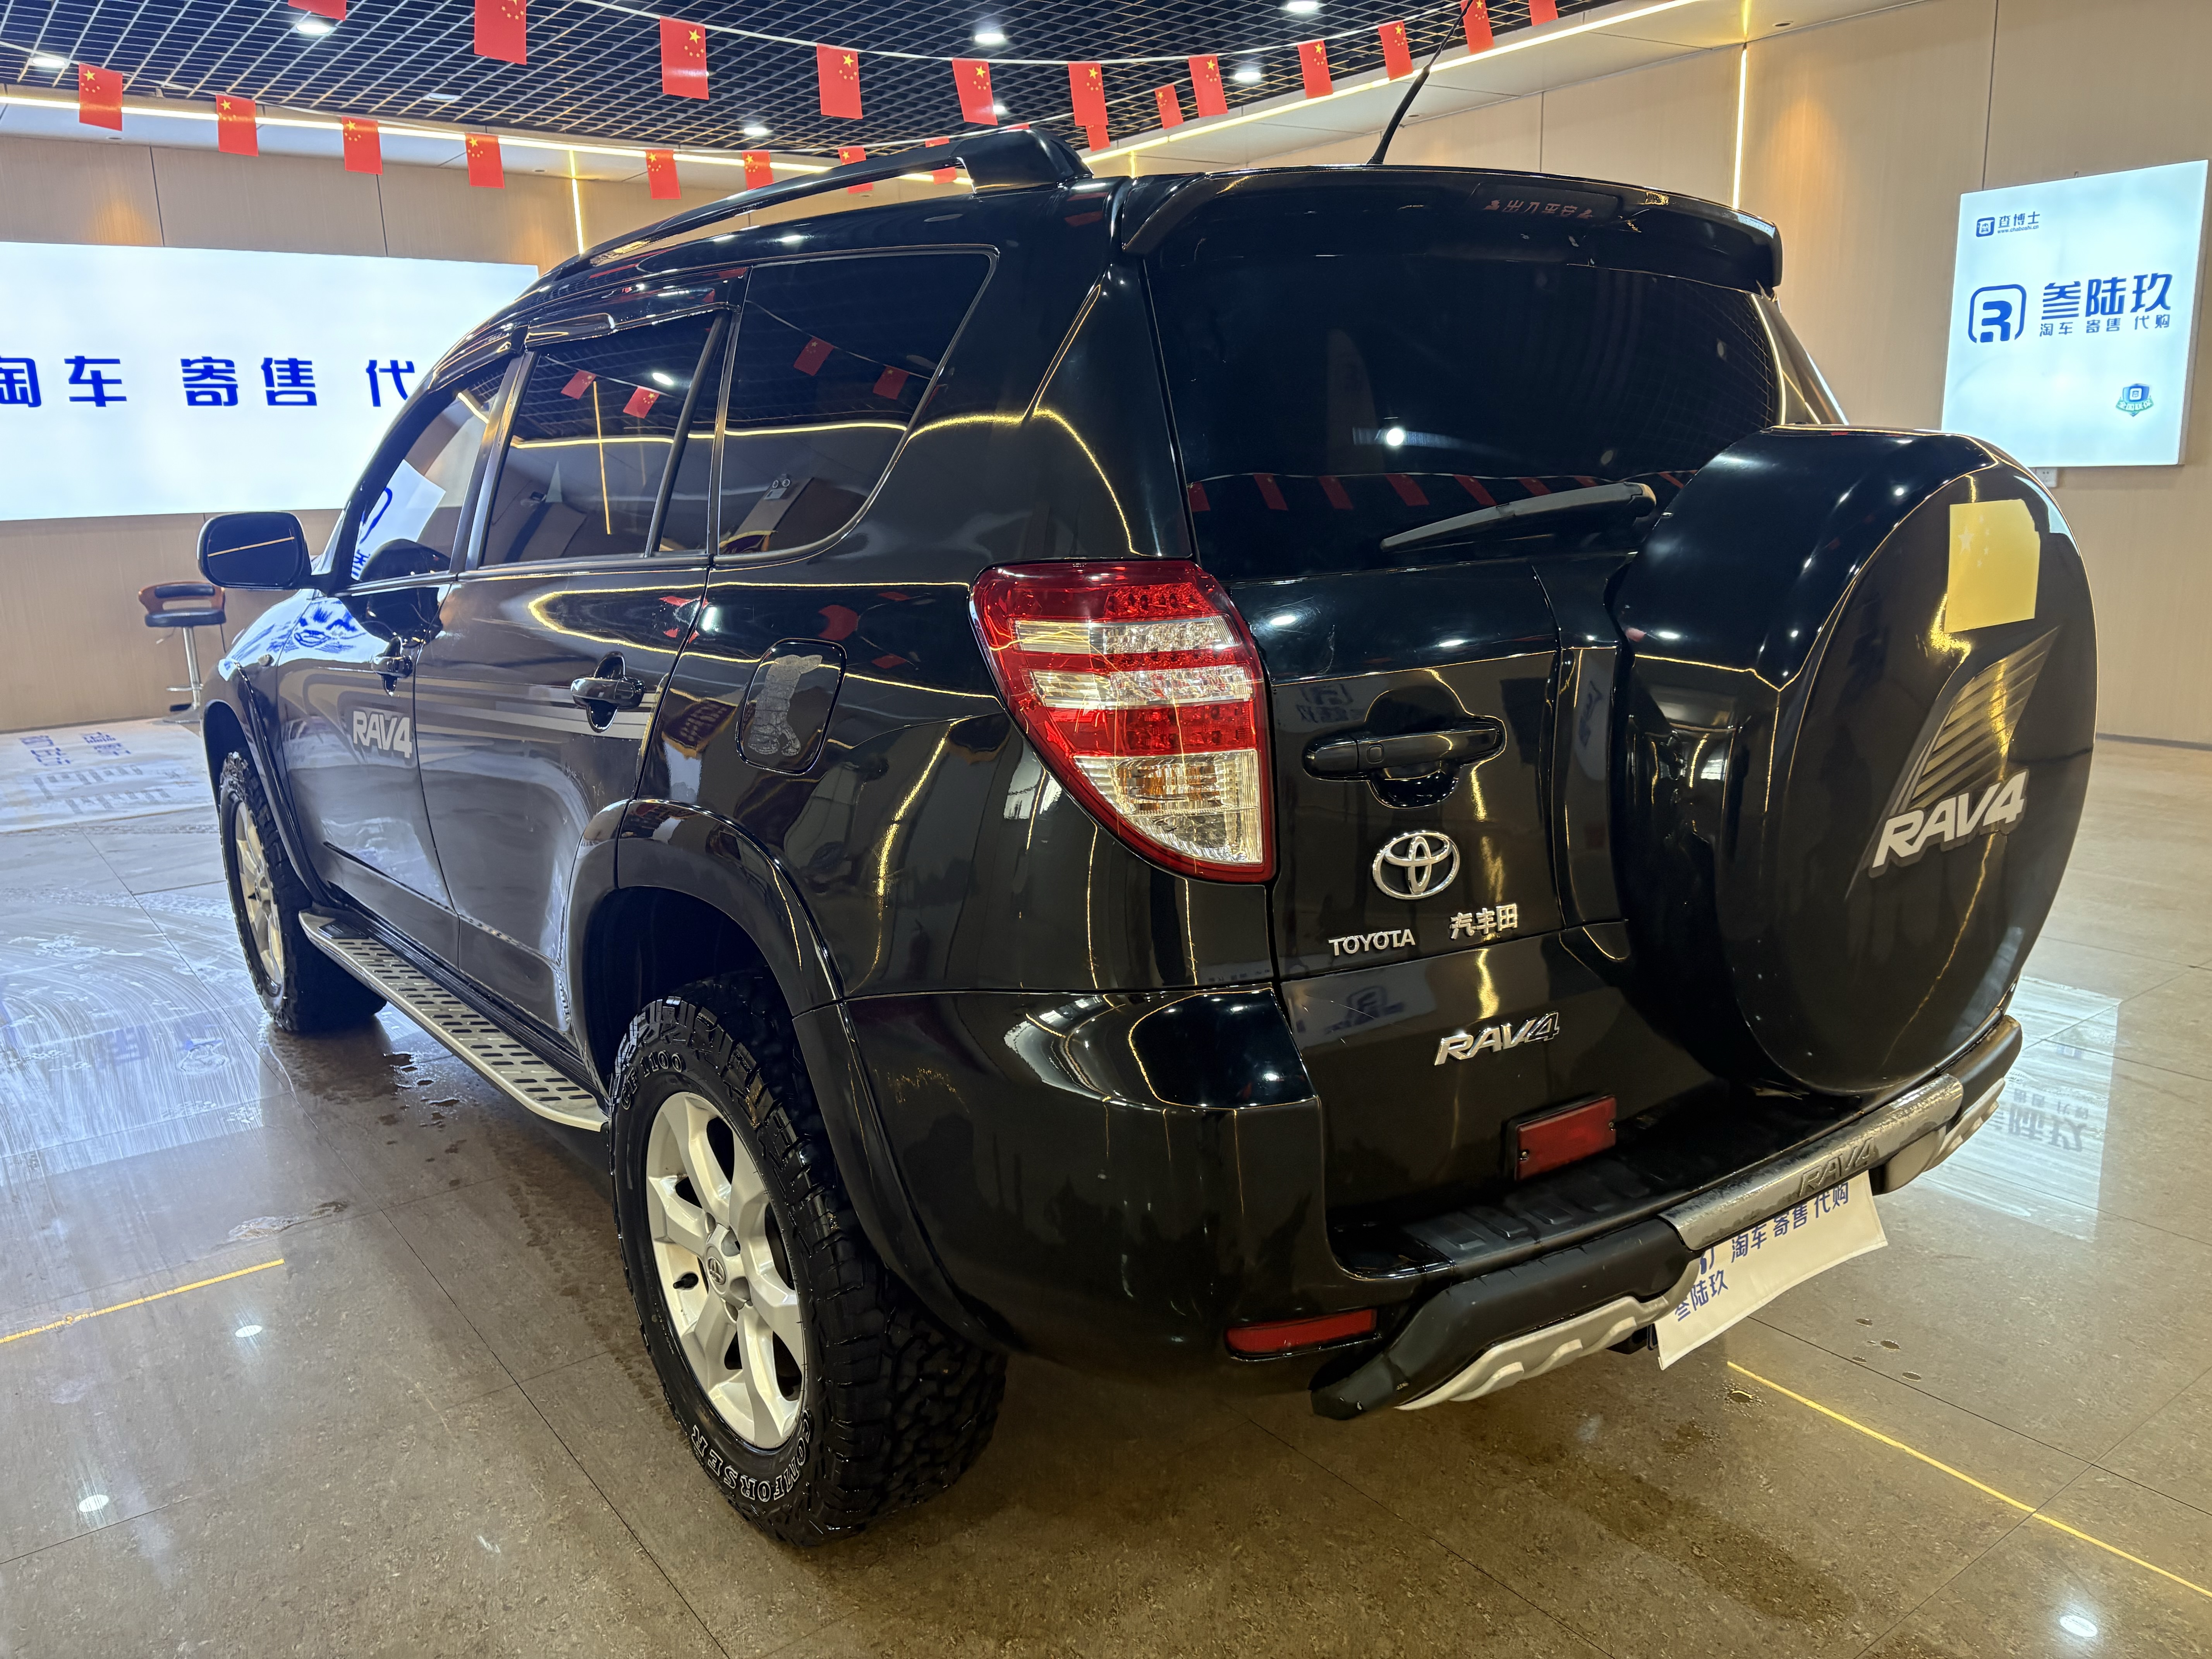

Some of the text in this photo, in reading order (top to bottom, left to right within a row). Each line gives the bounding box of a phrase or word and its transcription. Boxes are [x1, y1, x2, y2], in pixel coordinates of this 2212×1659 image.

[1998, 211, 2040, 228] 查博士
[2041, 273, 2173, 320] 叁陆玖
[2039, 314, 2170, 337] 淘车 寄售 代购
[180, 356, 318, 407] 寄售
[353, 711, 412, 759] RAV4
[1872, 771, 2027, 868] RAV4
[1329, 929, 1415, 956] TOYOTA
[1449, 903, 1518, 939] 汽丰田
[1434, 1011, 1559, 1066] RAV4
[621, 1050, 683, 1110] CF 1100
[1799, 1137, 1875, 1197] RAV4
[1731, 1223, 1767, 1263] 淘车
[1814, 1182, 1849, 1218] 代购
[691, 1410, 811, 1502] COMFORSER
